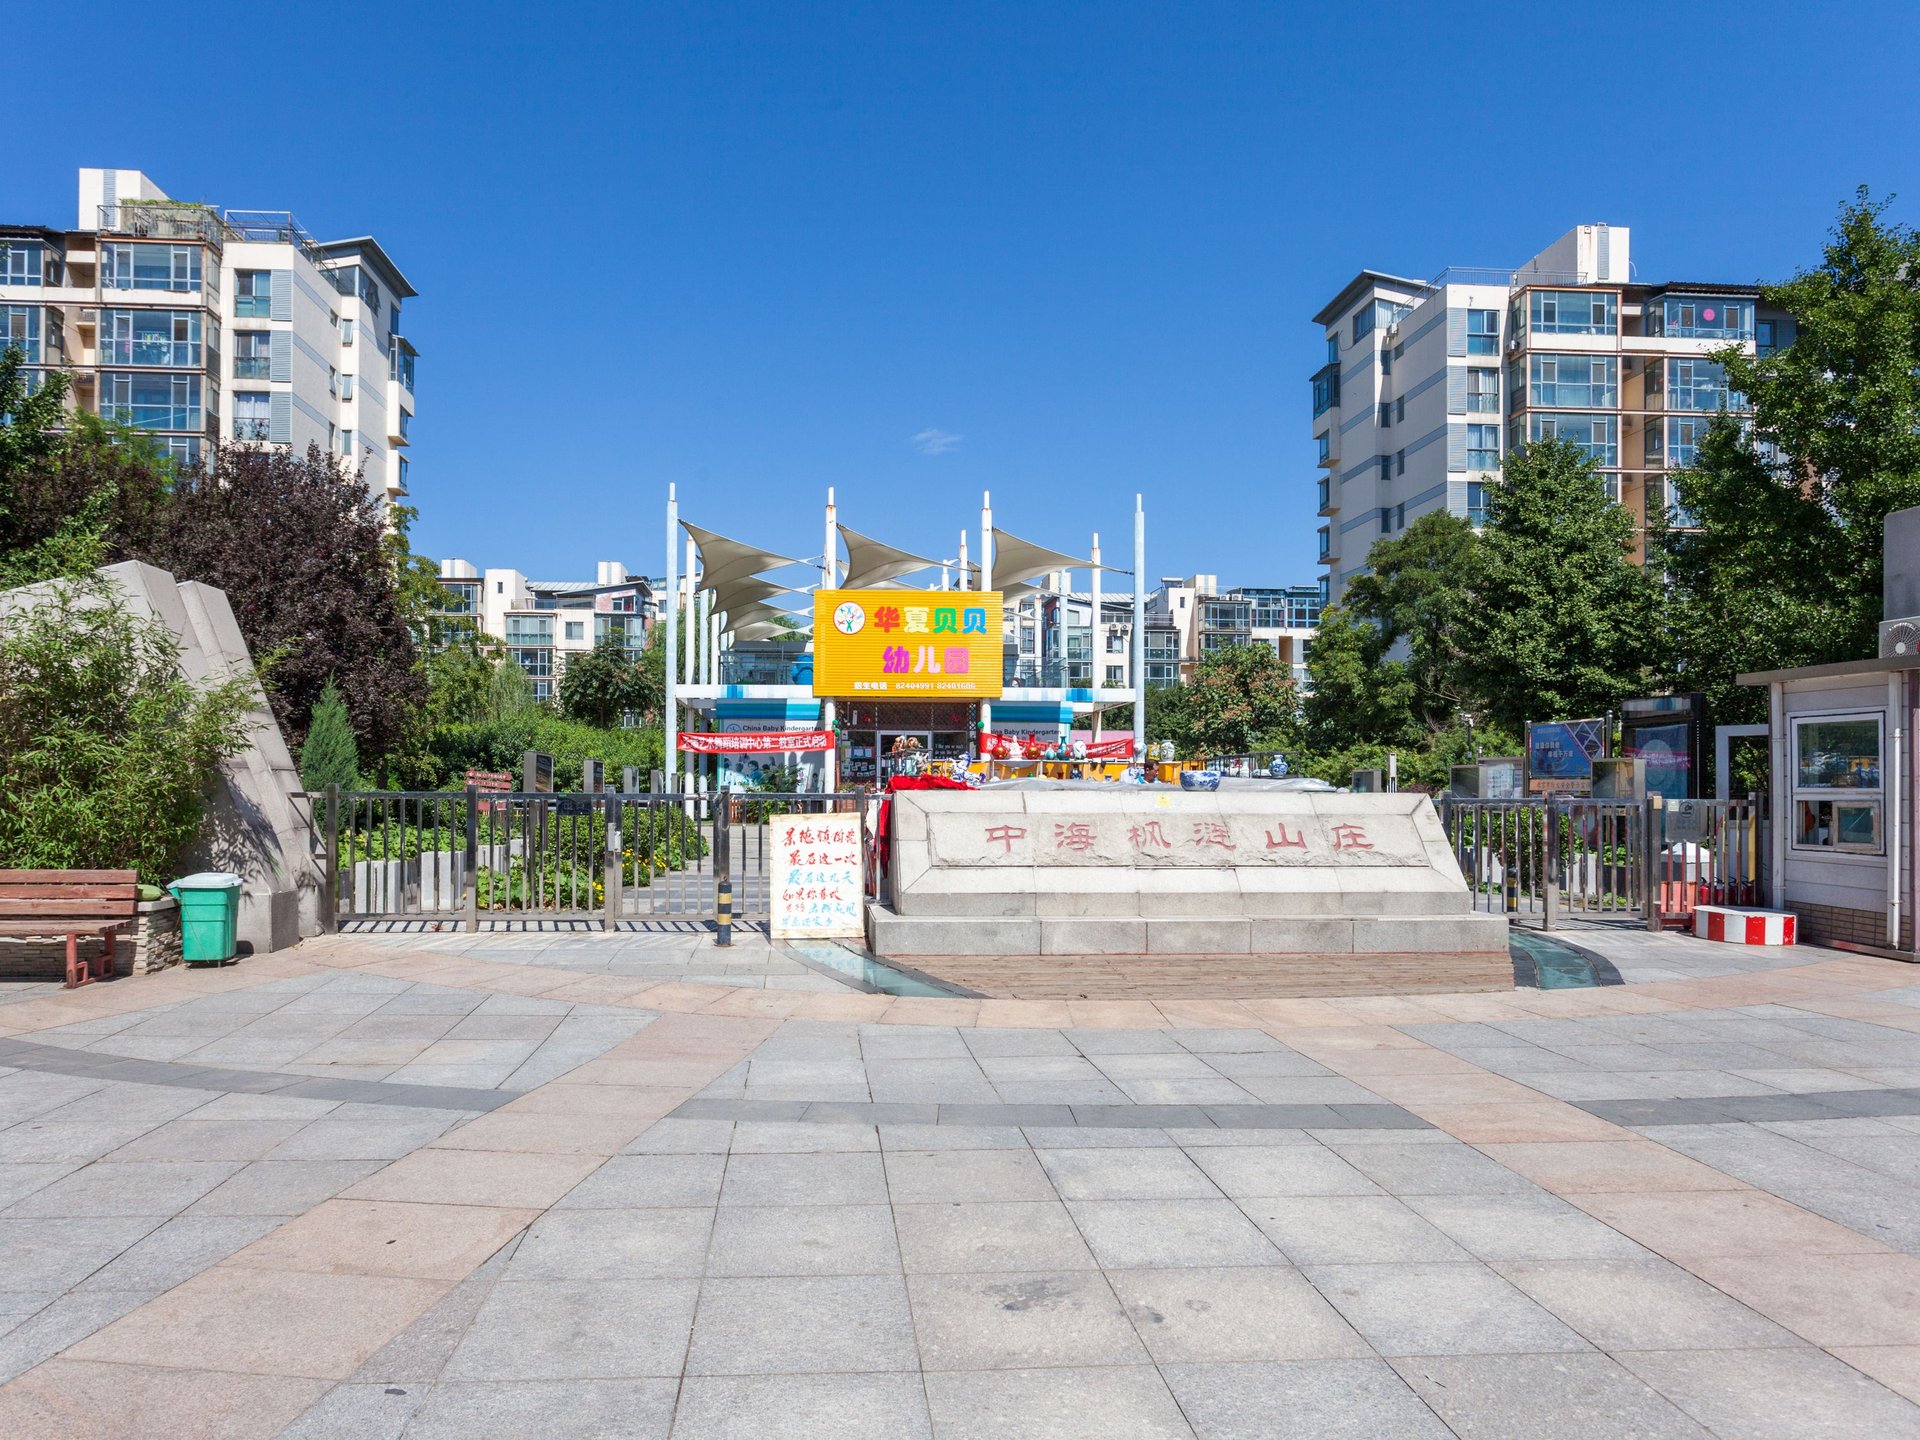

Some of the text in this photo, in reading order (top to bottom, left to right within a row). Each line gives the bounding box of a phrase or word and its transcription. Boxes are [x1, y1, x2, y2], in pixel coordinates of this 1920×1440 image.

[873, 606, 988, 634] 华夏贝贝
[882, 645, 970, 674] 幼儿园
[984, 821, 1375, 853] 中海枫涟山庄
[787, 849, 857, 866] 最后这一次
[787, 868, 853, 886] 最后这几天
